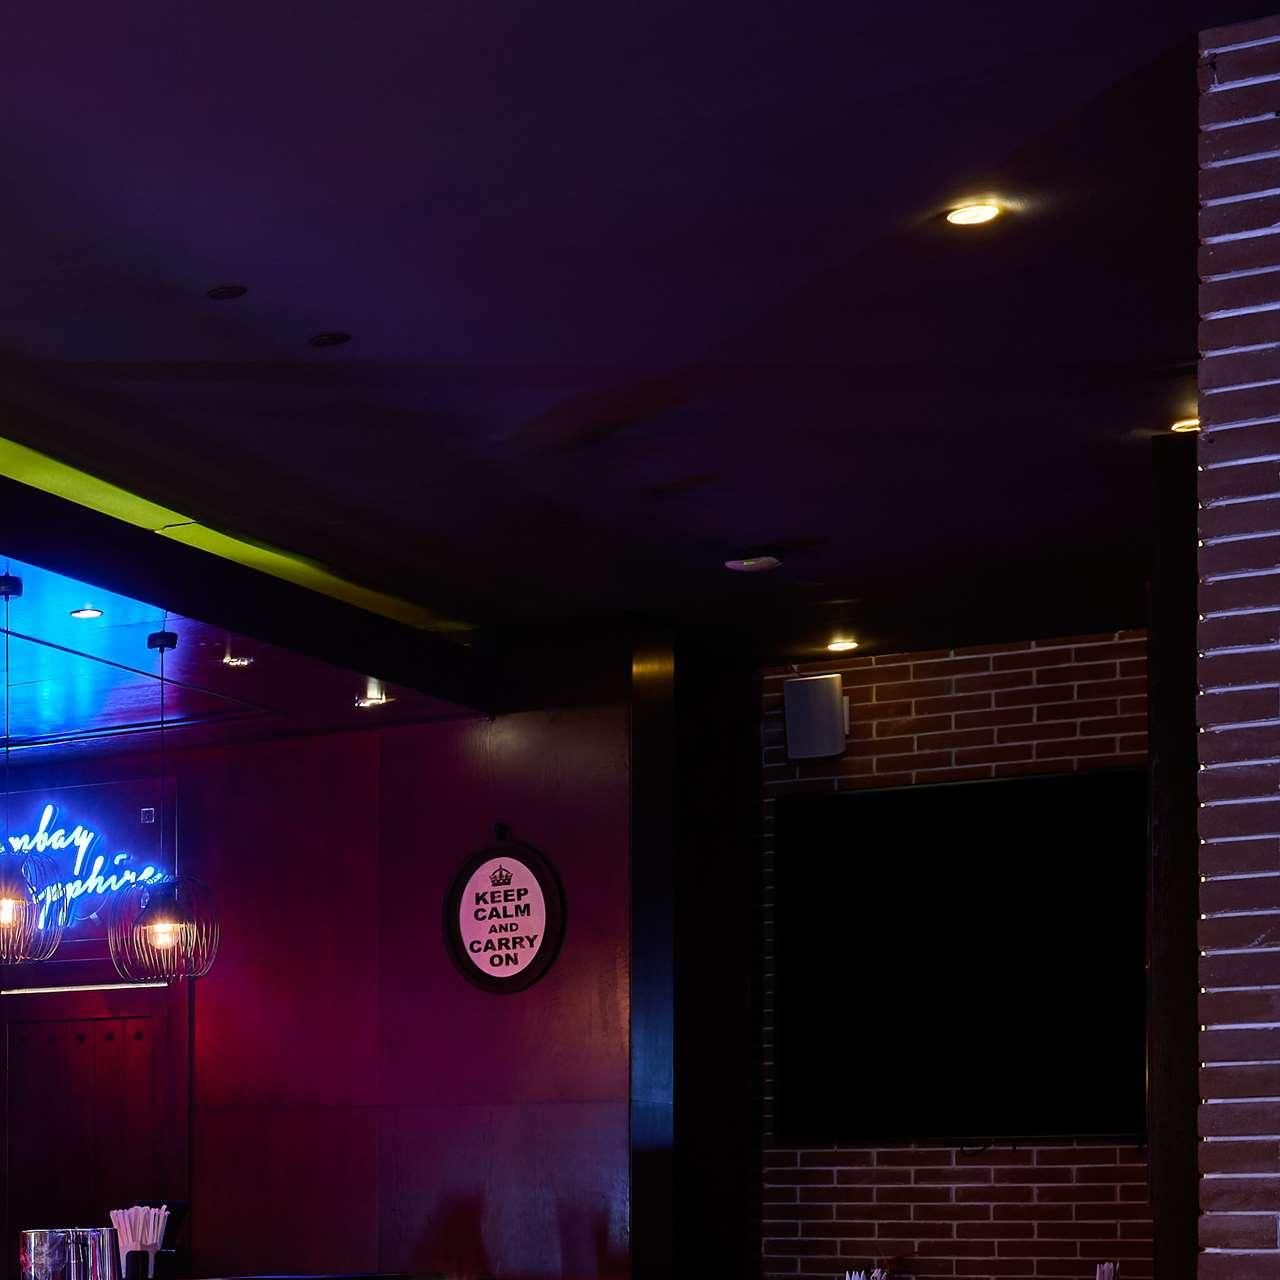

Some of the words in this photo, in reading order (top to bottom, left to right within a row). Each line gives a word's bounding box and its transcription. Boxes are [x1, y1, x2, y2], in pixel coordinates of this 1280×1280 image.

[475, 887, 529, 906] KEEP
[473, 903, 531, 921] CALM
[488, 922, 519, 934] AND
[469, 934, 539, 953] CARRY
[490, 952, 519, 967] ON
